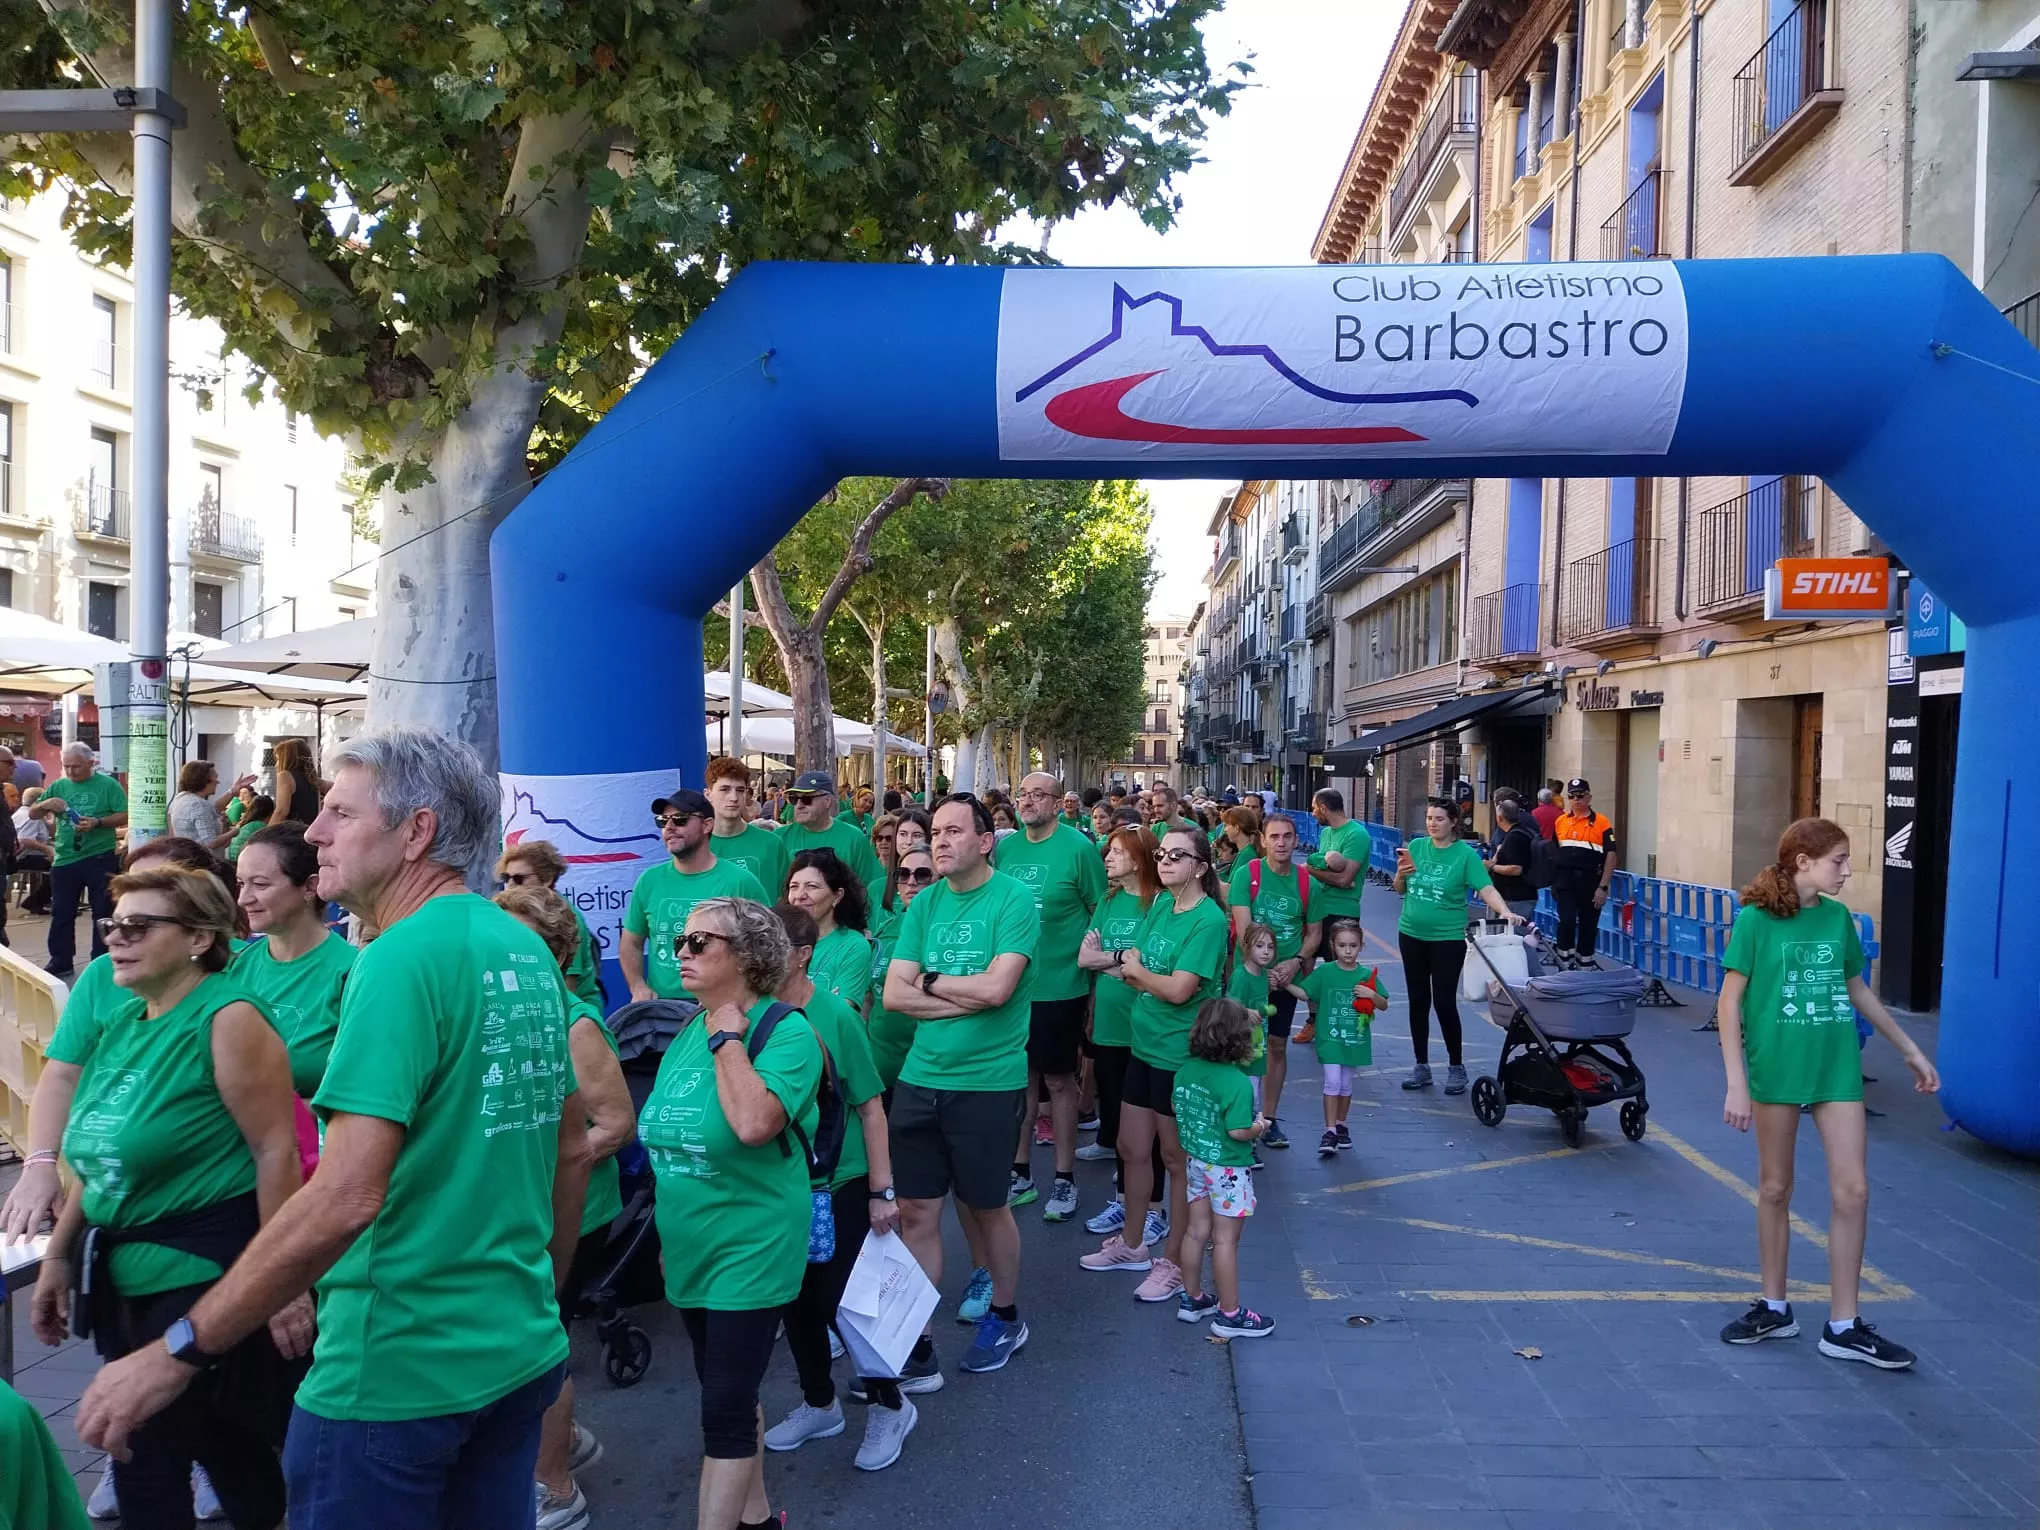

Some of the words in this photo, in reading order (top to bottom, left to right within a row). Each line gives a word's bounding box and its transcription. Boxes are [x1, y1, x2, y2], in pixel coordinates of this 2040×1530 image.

[1333, 275, 1441, 302] Club
[1457, 274, 1664, 300] Atletismo
[1335, 309, 1669, 363] Barbastro
[1792, 572, 1878, 594] STIHL
[1769, 664, 1782, 680] 37
[1888, 716, 1918, 728] Kawasaki
[1891, 739, 1913, 755] KTM
[1888, 766, 1914, 781] YAMAHA
[1459, 787, 1470, 799] P
[1892, 796, 1915, 807] SUZUKI
[1885, 857, 1913, 869] HONDA
[563, 884, 633, 911] tletis
